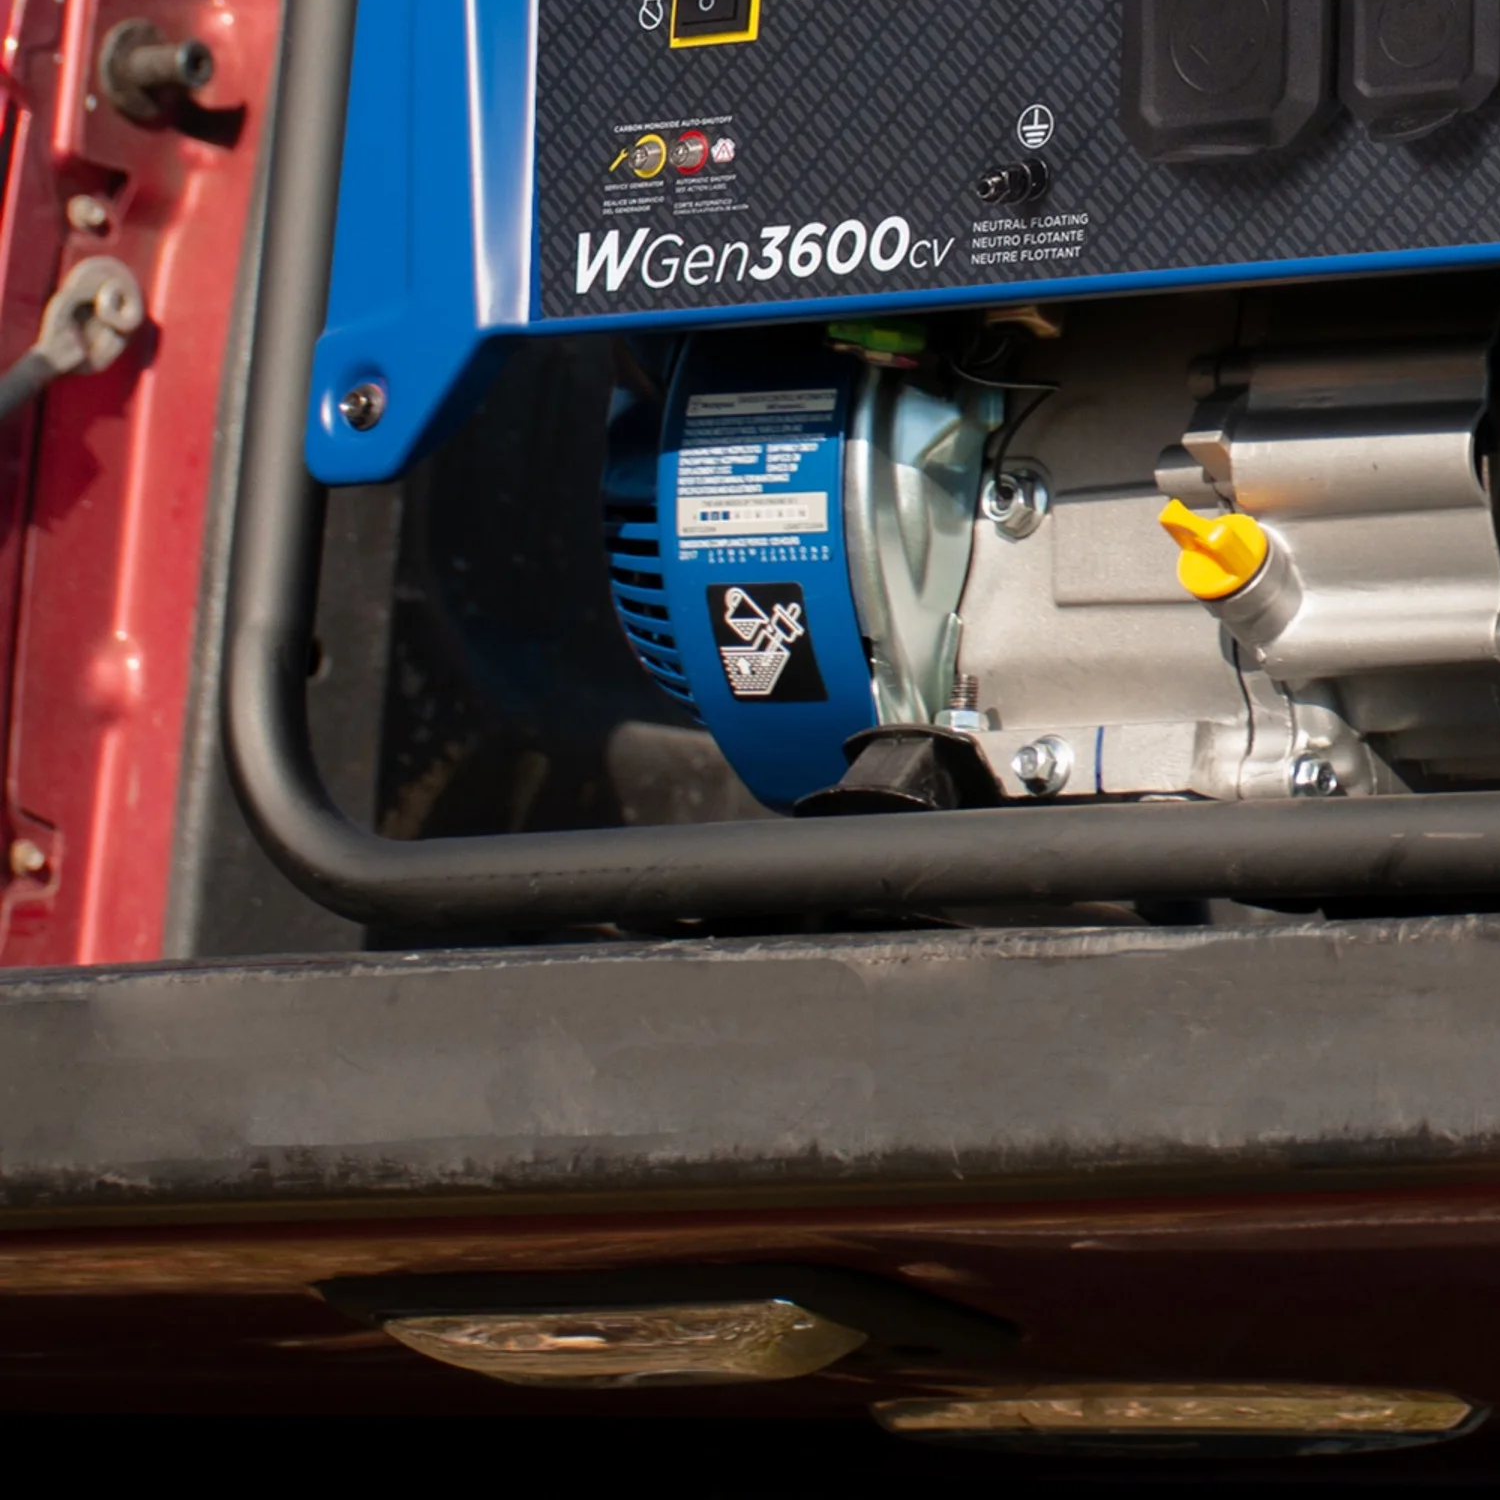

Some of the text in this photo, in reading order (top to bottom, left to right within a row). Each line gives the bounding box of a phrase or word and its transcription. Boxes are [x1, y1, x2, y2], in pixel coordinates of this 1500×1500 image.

[614, 123, 642, 133] CARBON
[644, 120, 680, 130] MONOXIDE
[972, 213, 1089, 233] NEUTRAL FLOATING
[971, 229, 1084, 249] NEUTRO FLOTANTE
[971, 246, 1082, 265] NEUTRE FLOTTANT
